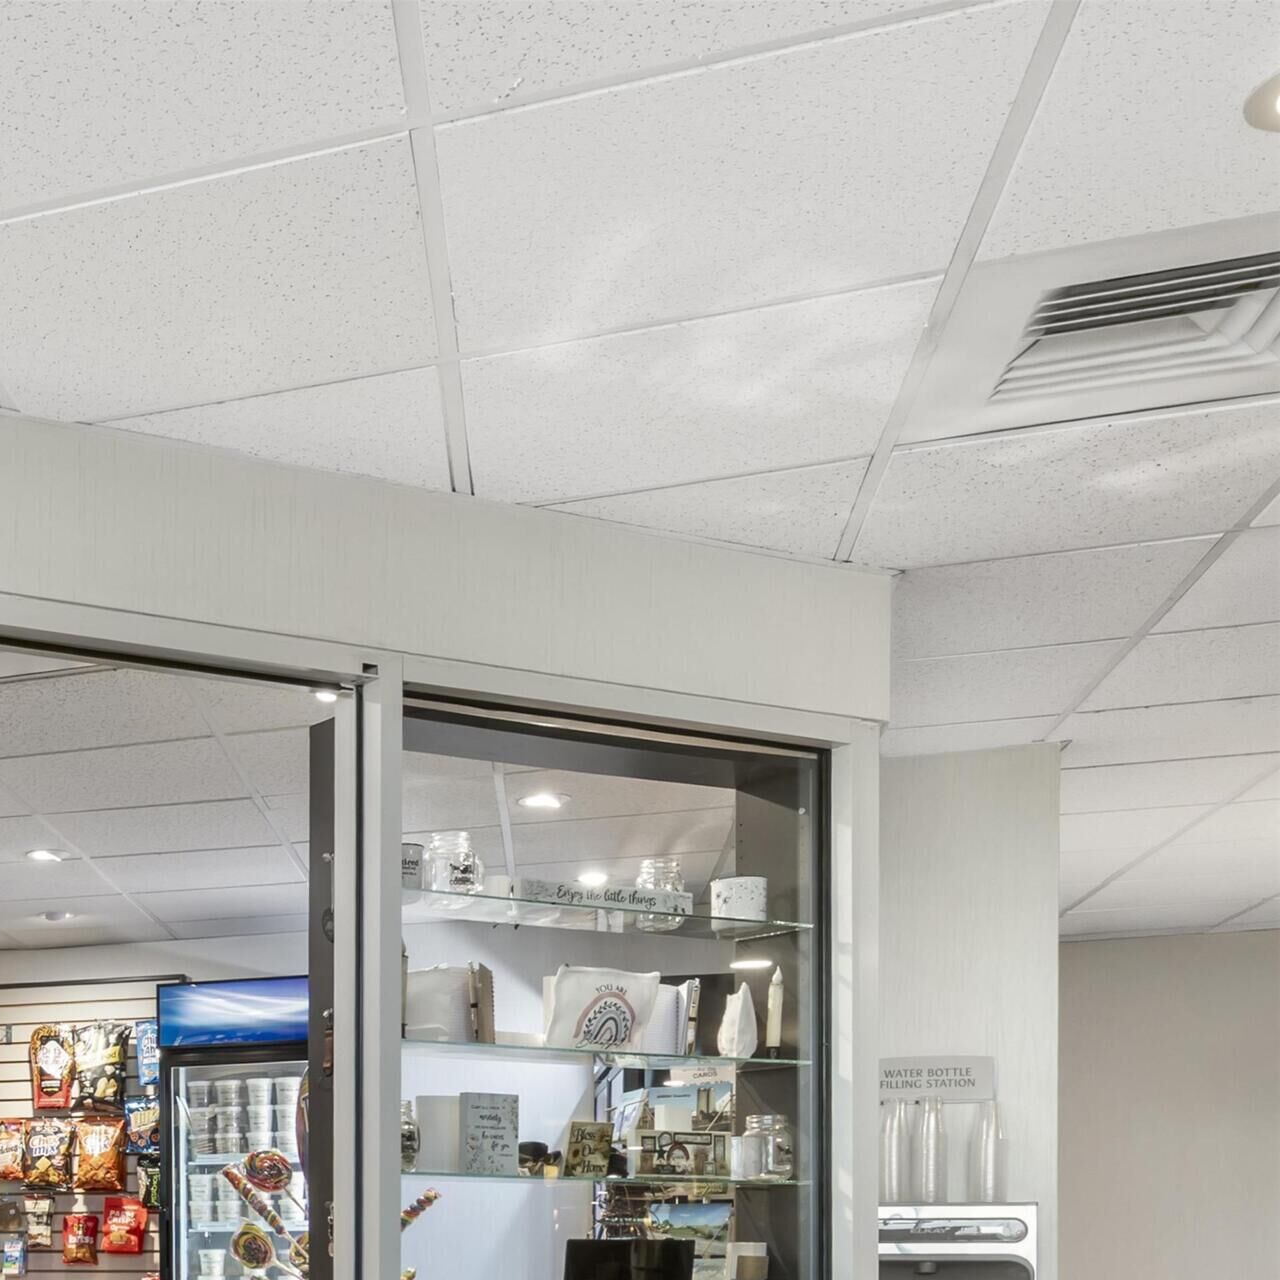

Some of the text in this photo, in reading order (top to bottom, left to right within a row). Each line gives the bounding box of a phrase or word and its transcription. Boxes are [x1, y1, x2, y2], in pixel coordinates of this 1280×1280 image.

[556, 885, 583, 904] Enjoy
[604, 889, 628, 903] little
[629, 891, 658, 911] things
[883, 1067, 972, 1079] WATER BOTTLE
[880, 1078, 977, 1089] FILLING STATION
